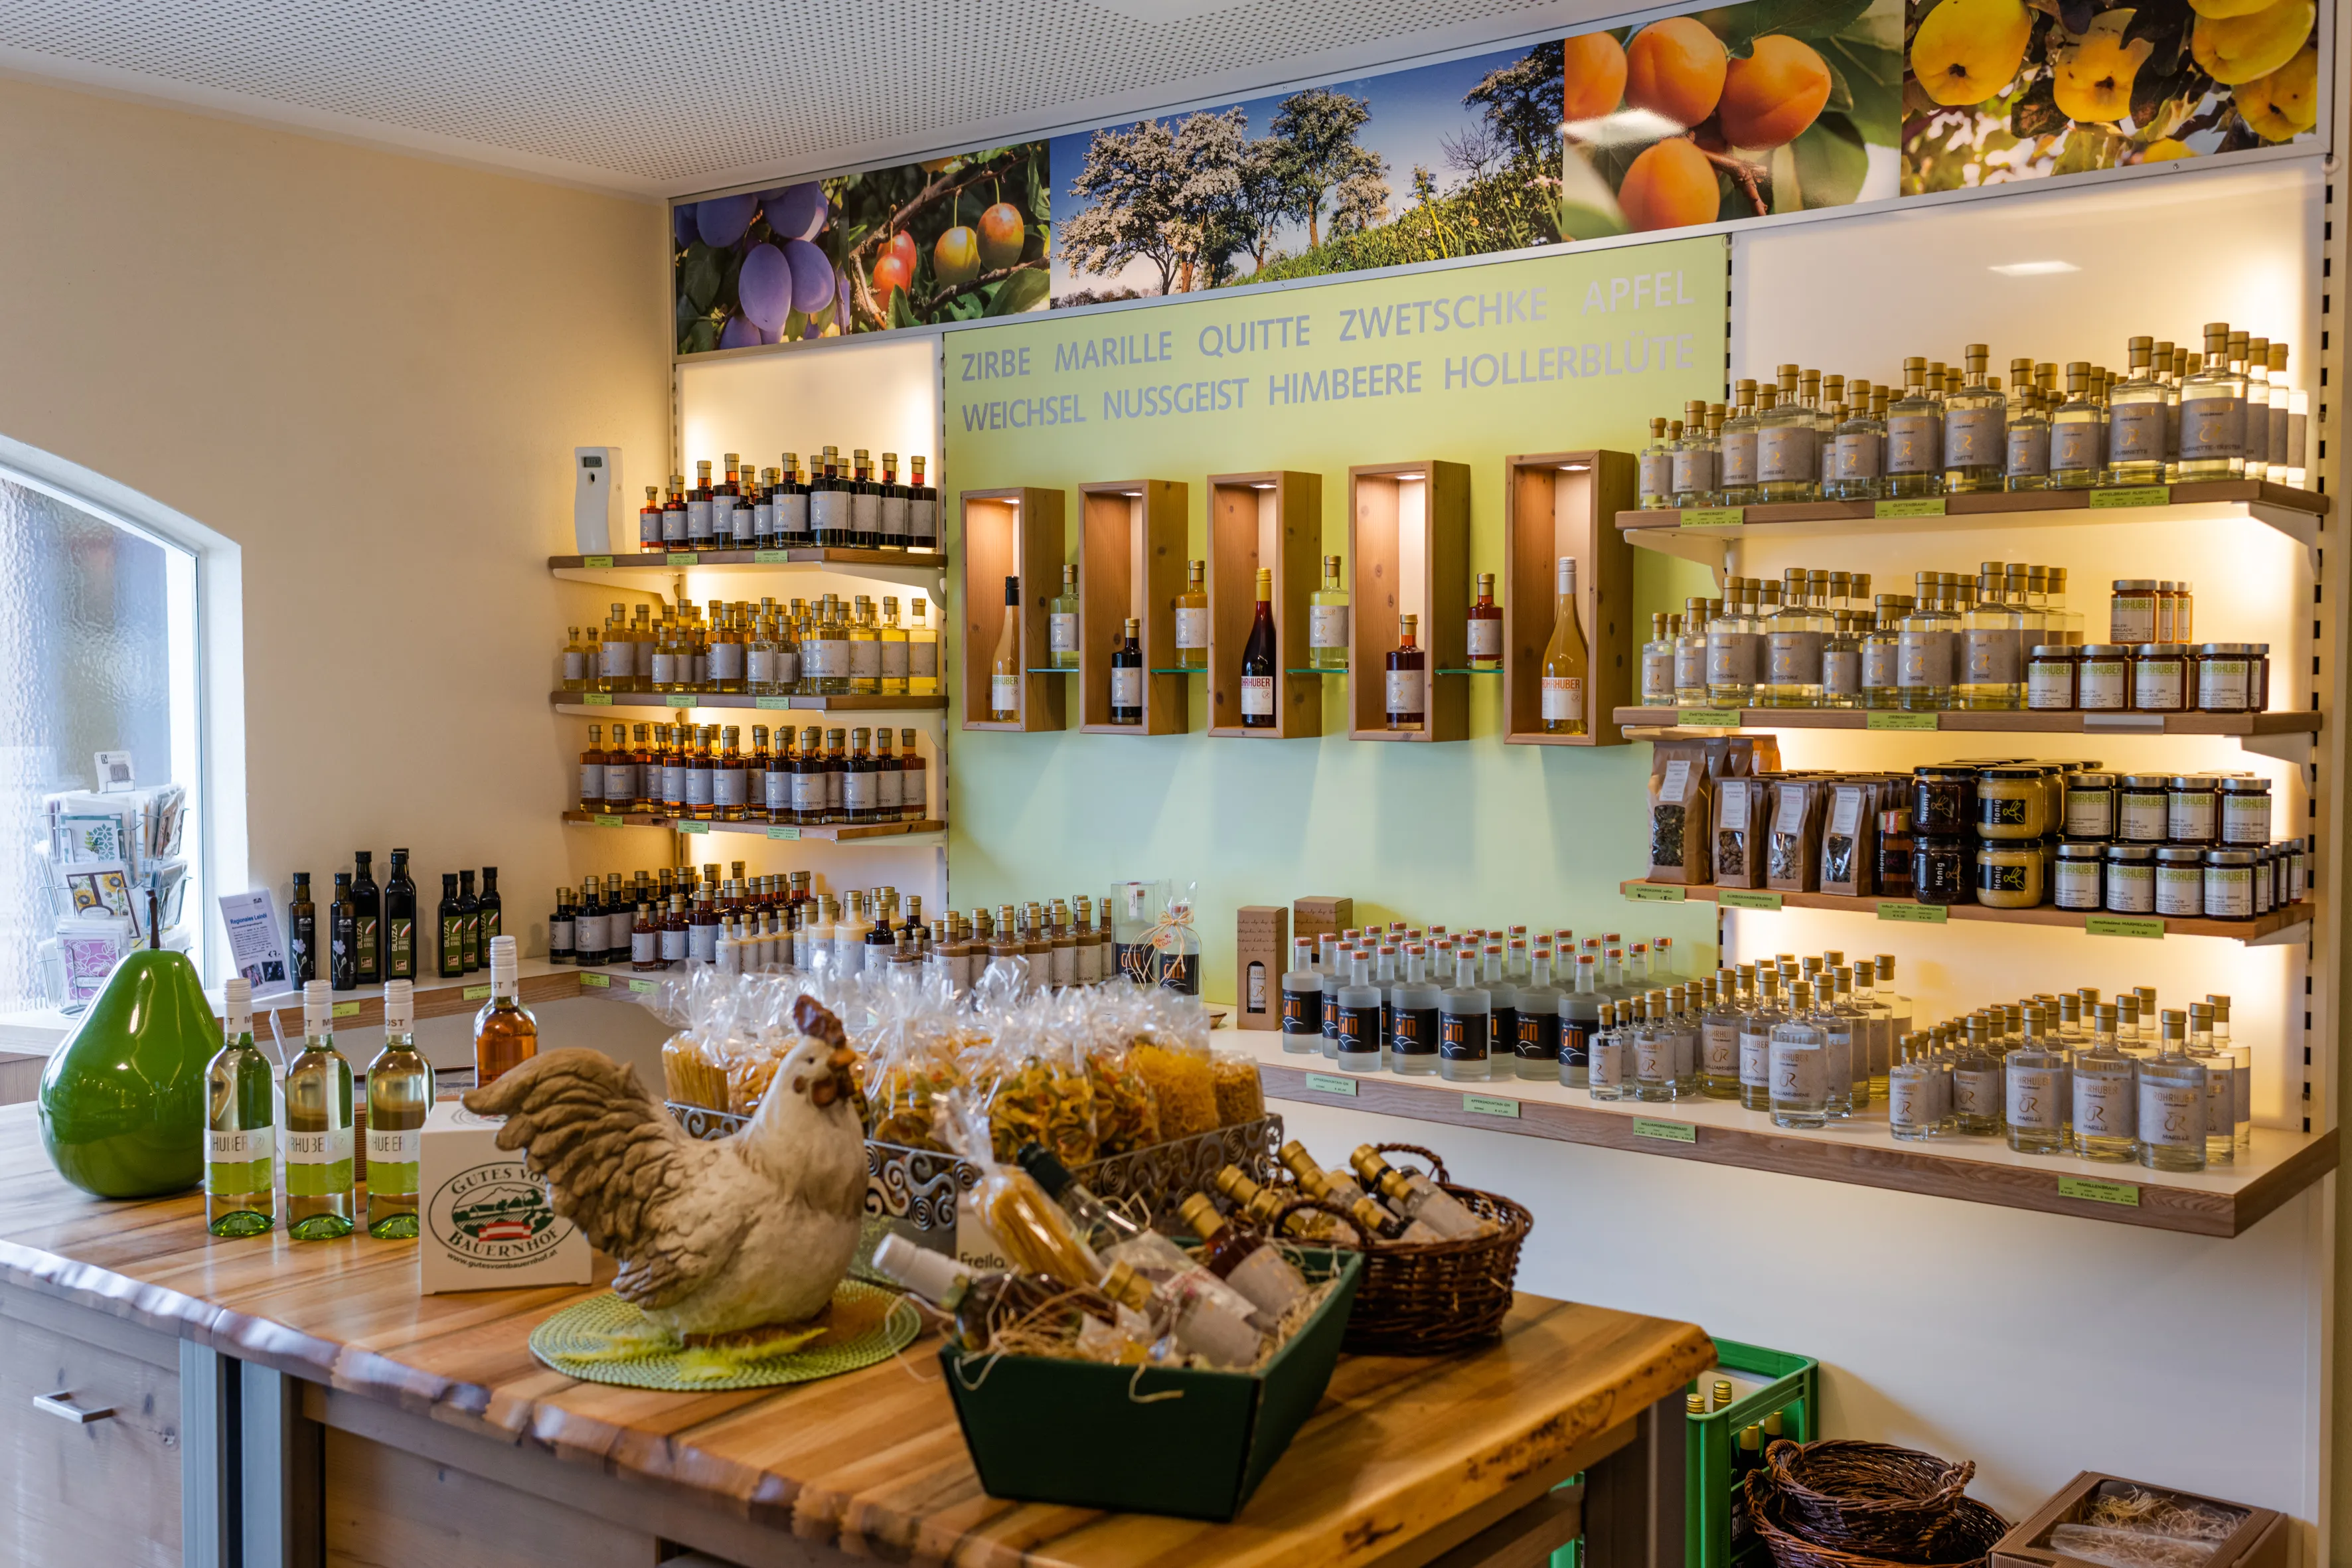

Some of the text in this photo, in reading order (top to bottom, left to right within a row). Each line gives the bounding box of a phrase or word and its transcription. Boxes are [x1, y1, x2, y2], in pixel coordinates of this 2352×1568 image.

[961, 270, 1695, 382] ZIRBE MARILLE QUITTE ZWETSCHKE APFEL
[962, 329, 1694, 432] WEICHSEL NUSSGEIST HIMBEERE HOLLERBLÜTE
[1241, 678, 1271, 688] OHRHUBER
[1542, 678, 1581, 690] ROHRHUBER
[2124, 795, 2167, 807] ROHRHUBER
[2169, 794, 2213, 806] ROHRHUBER
[2226, 797, 2271, 809] ROHRHUBER
[1994, 799, 2002, 823] Honig
[1936, 862, 1944, 886] Honig
[1994, 866, 2003, 890] Honig
[2109, 867, 2153, 879] ROHRHUBER
[2158, 869, 2203, 882] ROHRHUBER
[2205, 869, 2250, 882] ROHRHUBER
[230, 915, 254, 925] Regionales
[1283, 1000, 1301, 1017] GIN
[1338, 1016, 1358, 1035] GIN
[1395, 1018, 1417, 1036] GIN
[1443, 1023, 1464, 1042] GIN
[1518, 1022, 1538, 1041] GIN
[1561, 1029, 1584, 1048] GIN
[2076, 1082, 2118, 1095] RHRHUBER
[2153, 1091, 2198, 1103] ROHRHUBER
[1640, 1122, 1687, 1132] WILLIAMSBIRNENBRAND
[2017, 1115, 2043, 1123] MARILLE
[212, 1136, 248, 1152] HUBER
[289, 1137, 333, 1153] RHUBER
[451, 1167, 548, 1194] GUTES VO
[2077, 1182, 2120, 1192] MARILLENBRAND
[448, 1226, 559, 1257] BAUERNHOF
[447, 1249, 558, 1270] www.gutesvombauernhof.at
[960, 1251, 1006, 1269] Freila
